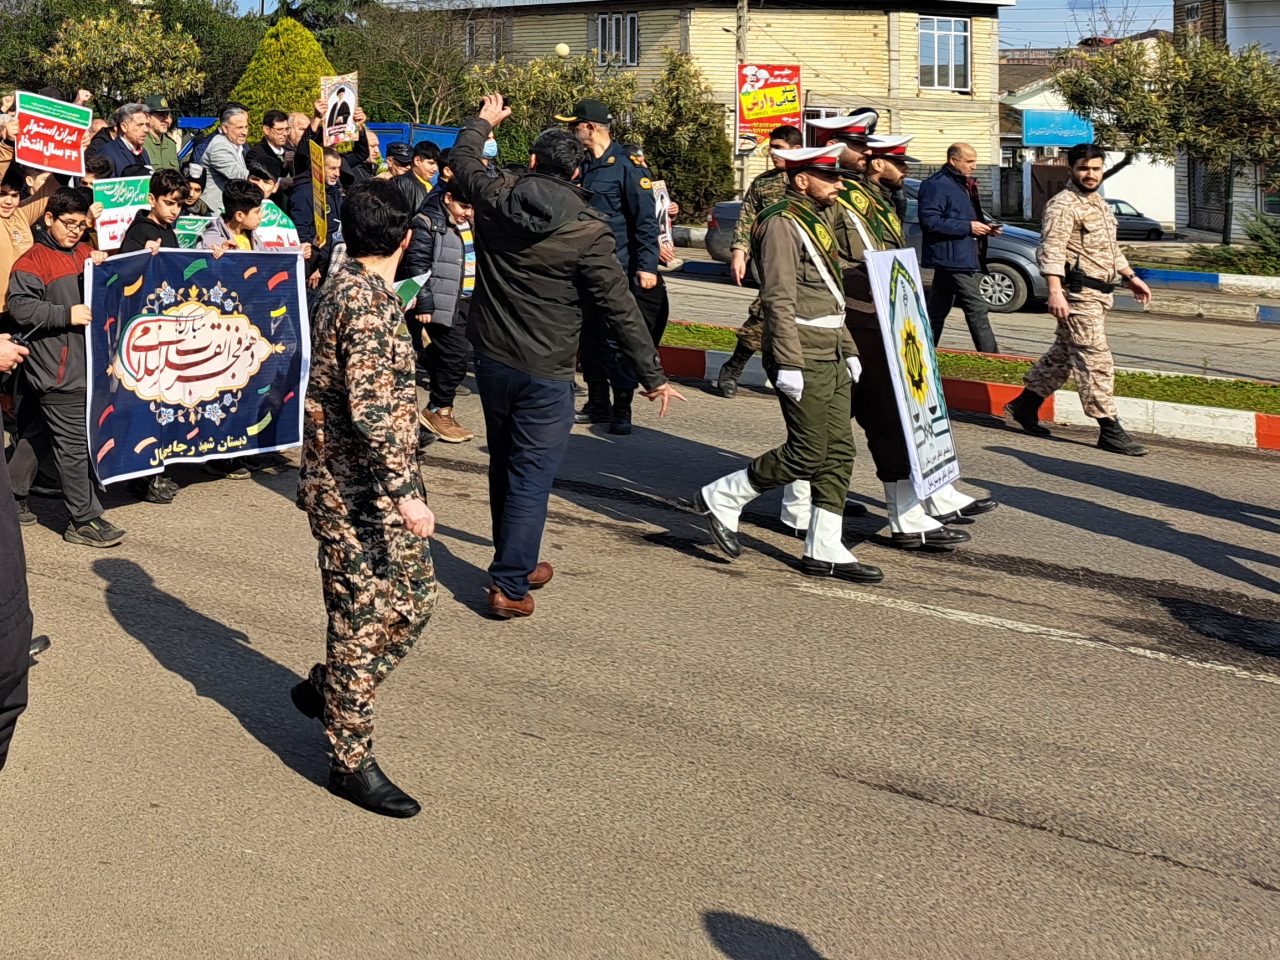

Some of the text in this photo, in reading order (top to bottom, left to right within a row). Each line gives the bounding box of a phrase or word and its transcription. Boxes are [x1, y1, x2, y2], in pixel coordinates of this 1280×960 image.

[23, 119, 78, 145] ایران استوار
[18, 134, 44, 153] افتخار
[43, 142, 64, 157] سال
[217, 434, 248, 452] دبستان
